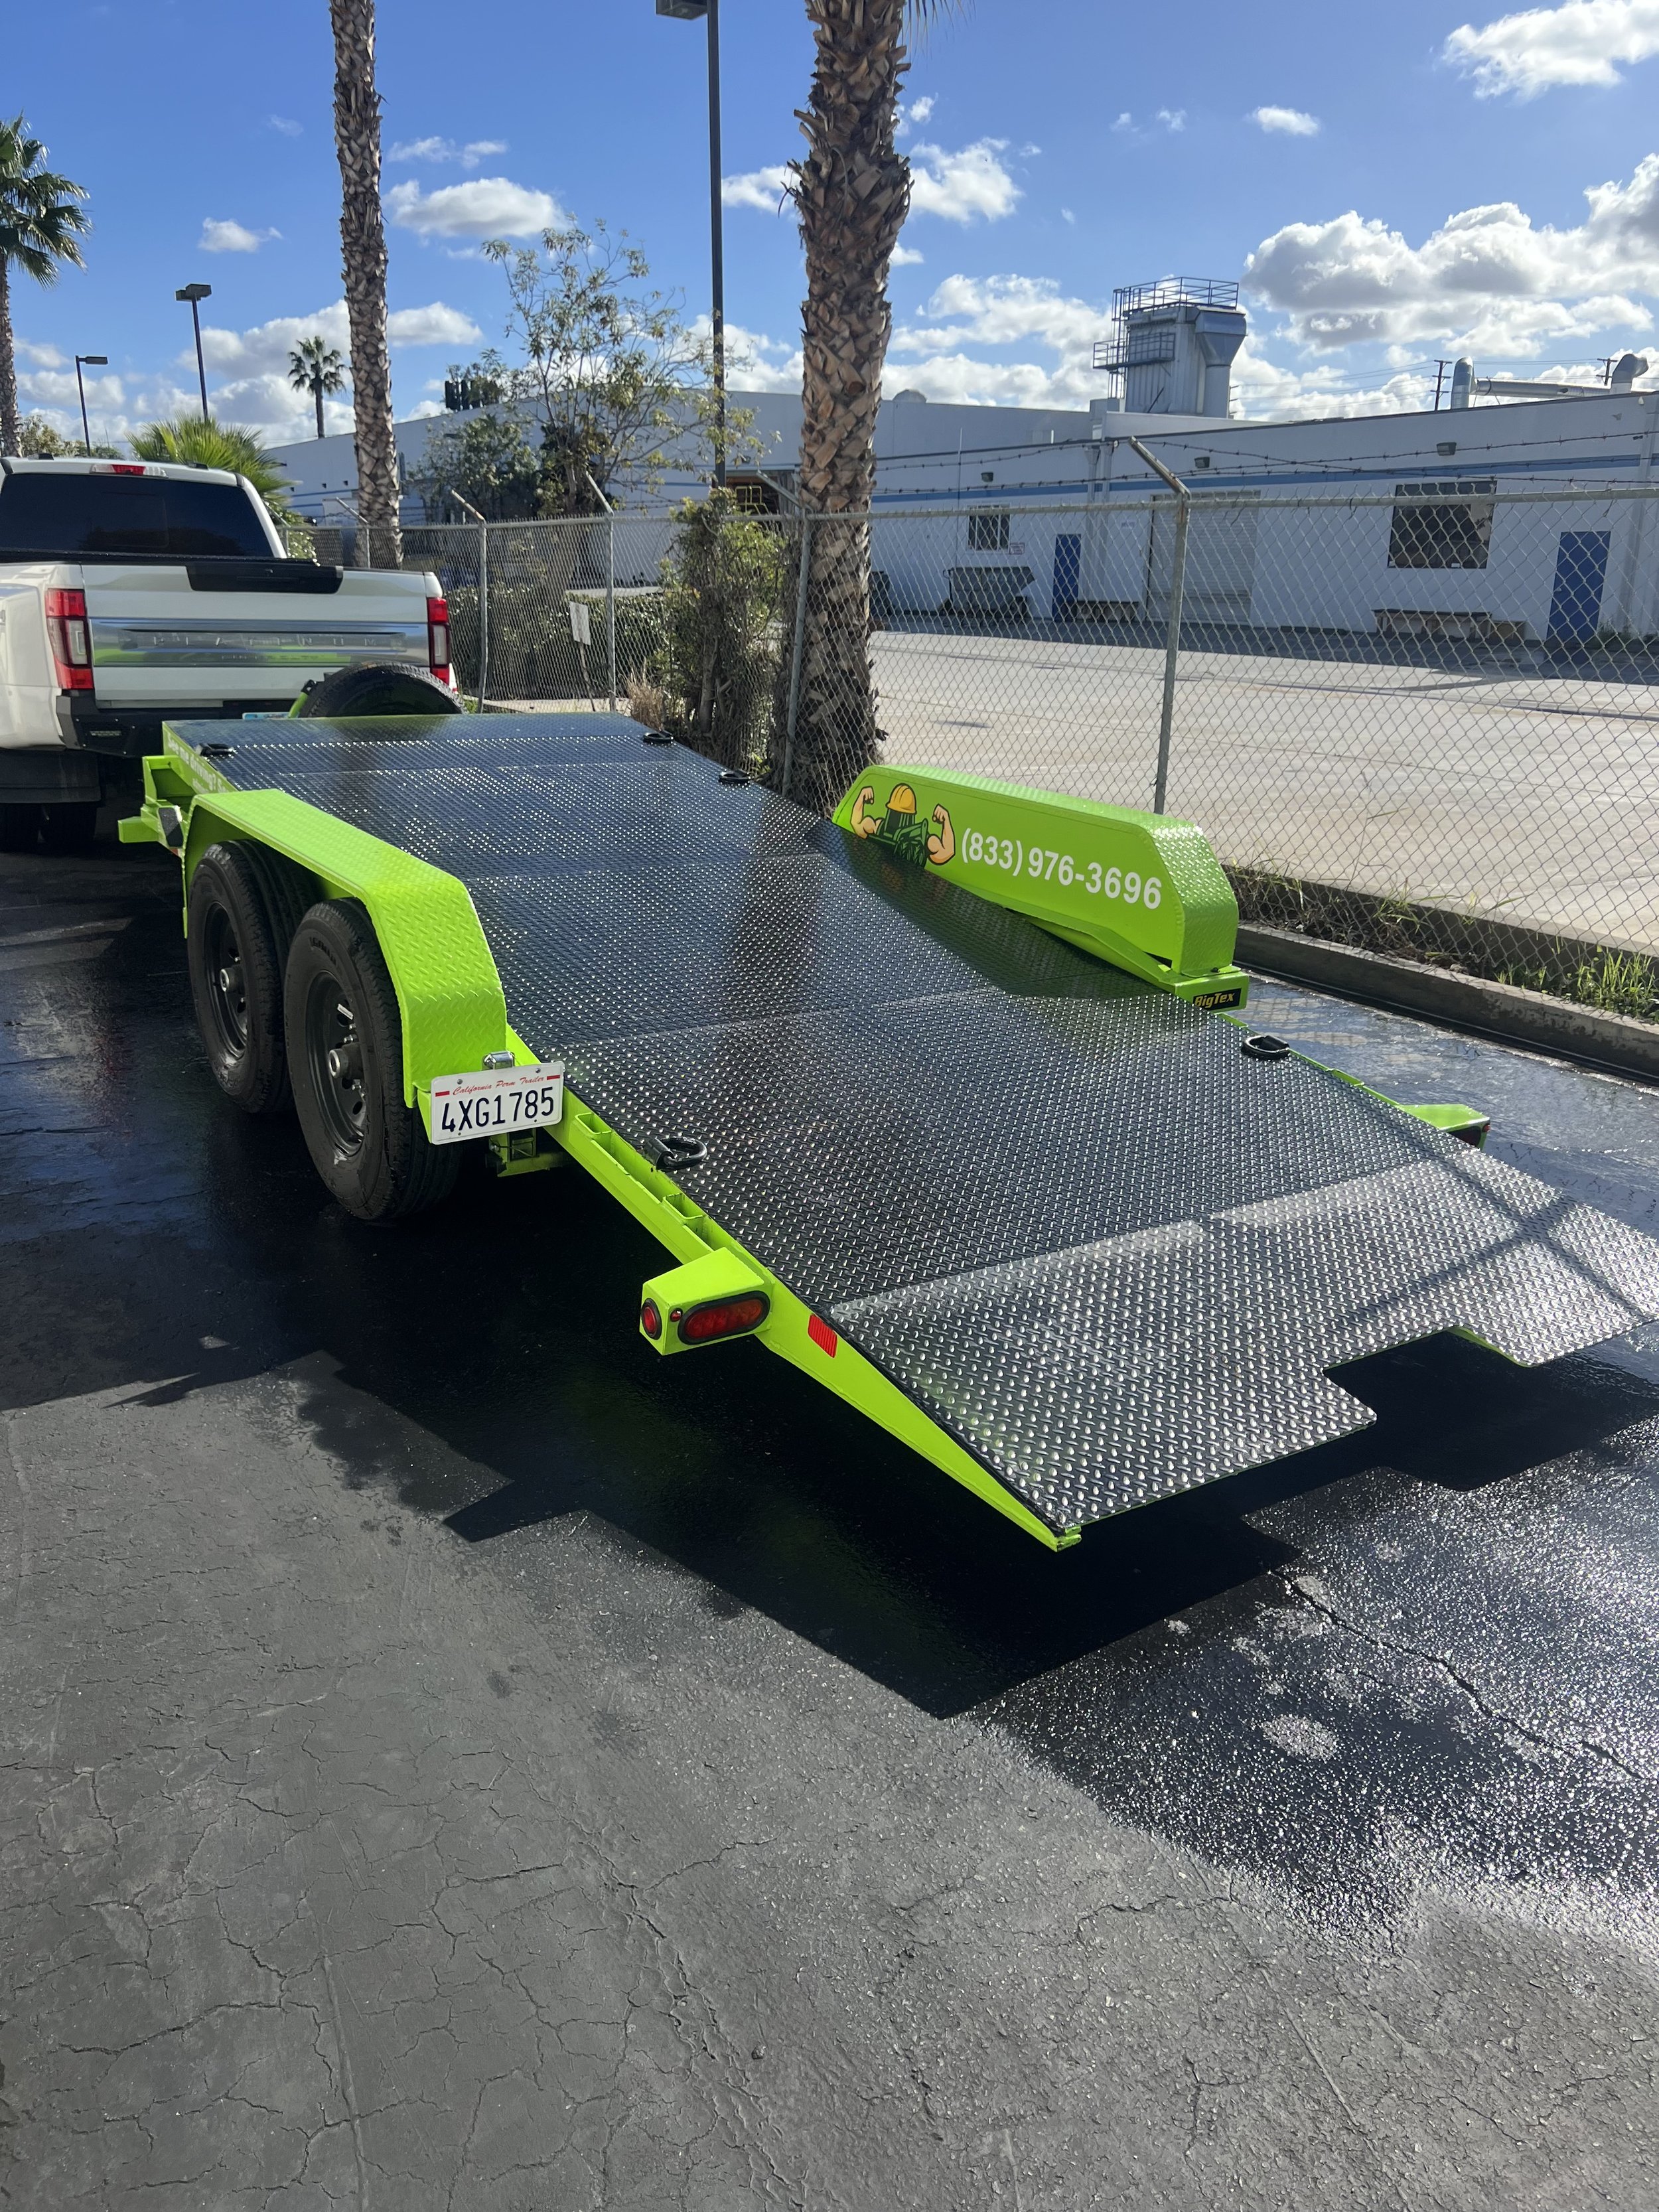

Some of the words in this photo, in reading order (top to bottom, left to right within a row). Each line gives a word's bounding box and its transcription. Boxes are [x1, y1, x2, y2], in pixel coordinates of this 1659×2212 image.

[153, 636, 378, 647] PLATINUM
[962, 828, 1023, 877] (833)
[1028, 847, 1162, 909] 976-3696
[453, 1084, 492, 1096] California
[495, 1080, 516, 1088] Perm
[520, 1076, 545, 1084] Trailer
[441, 1086, 554, 1132] 4XG1785
